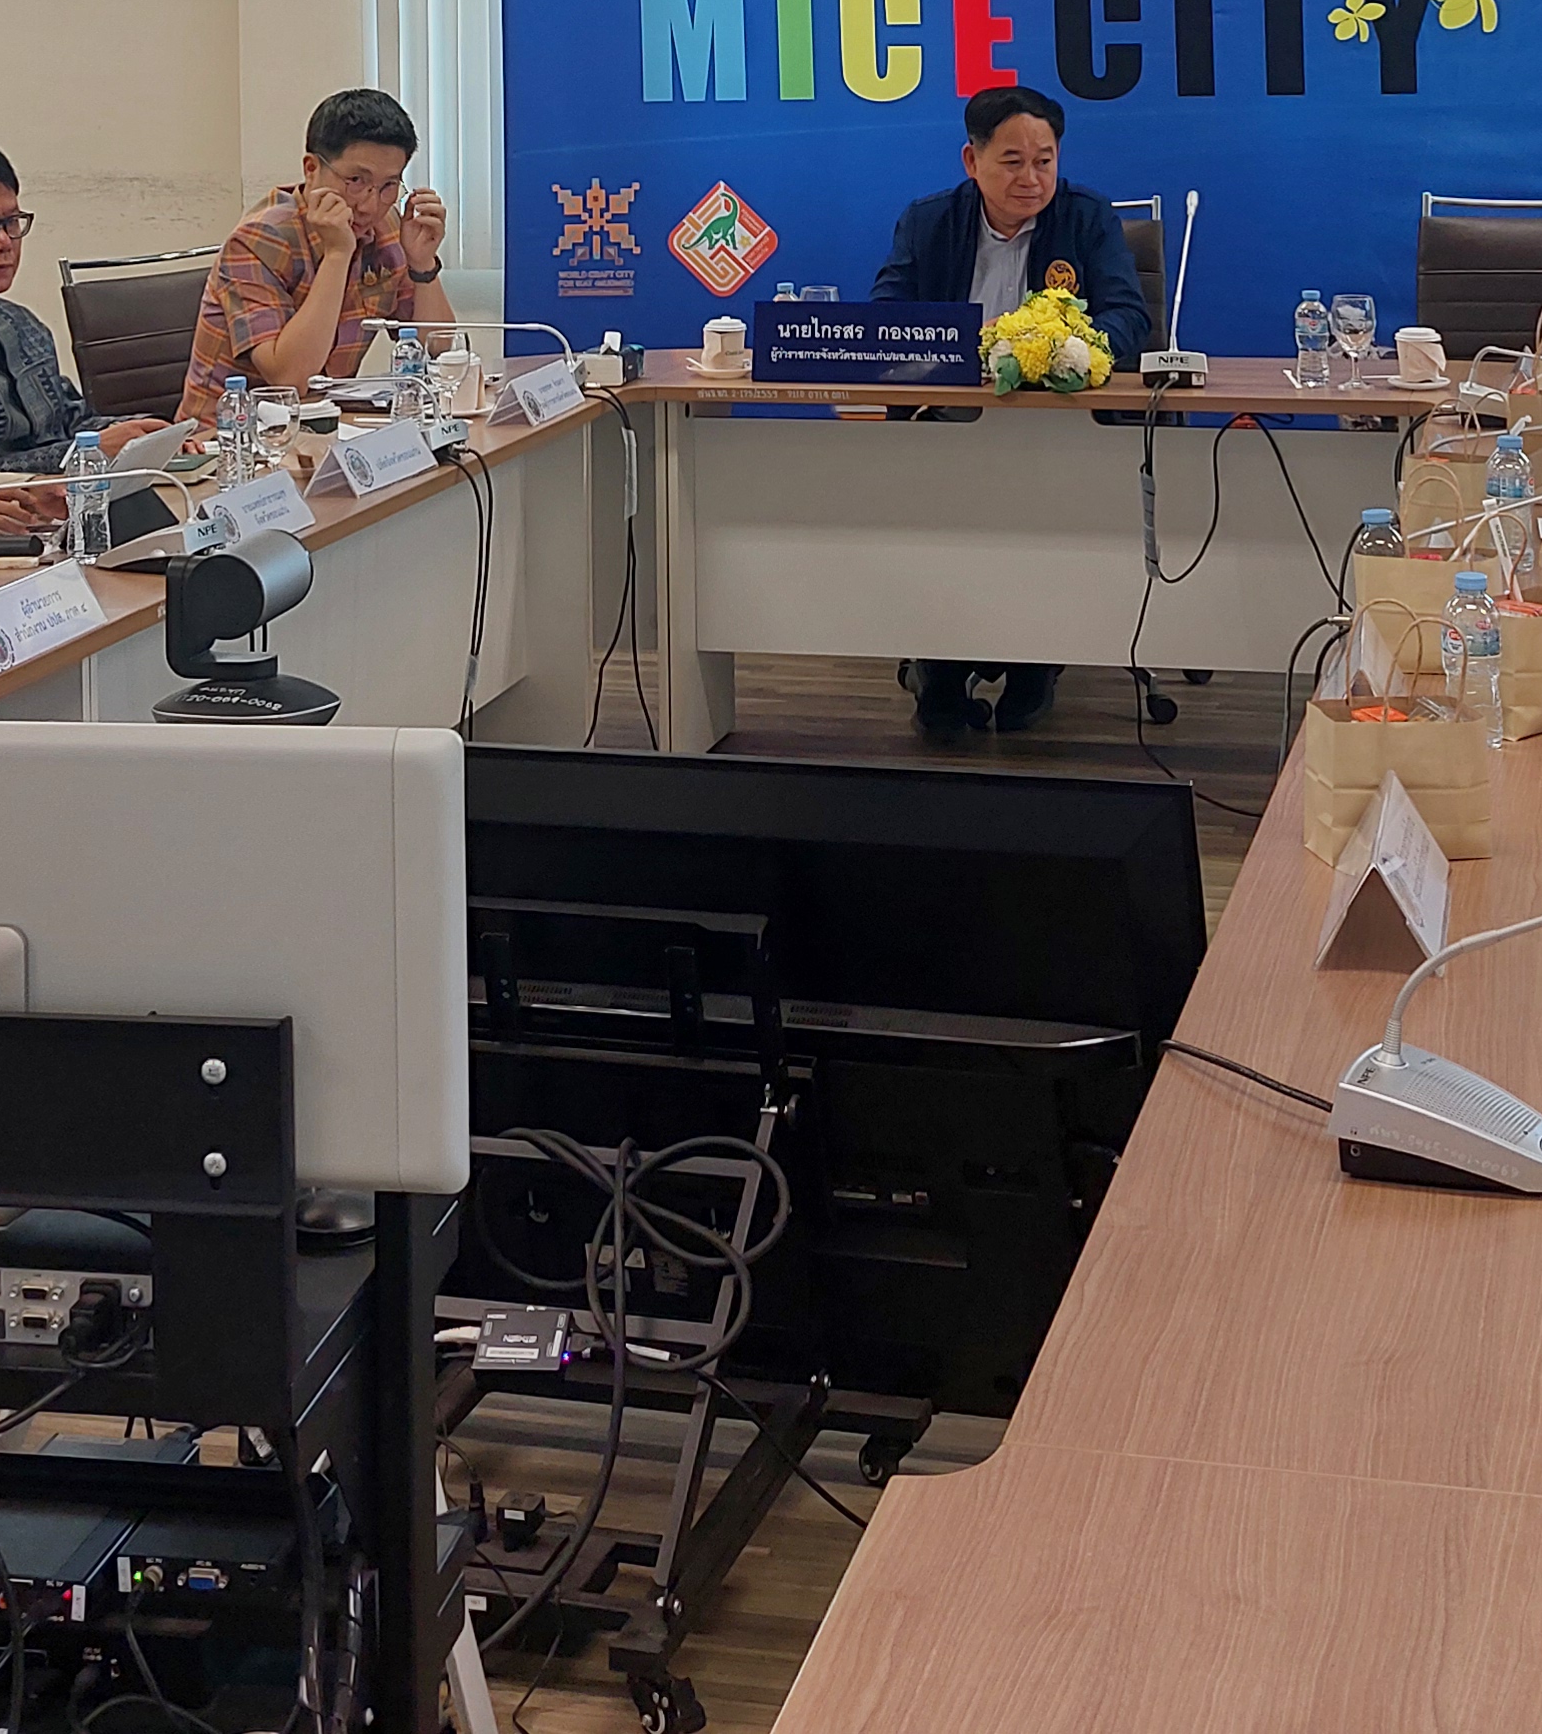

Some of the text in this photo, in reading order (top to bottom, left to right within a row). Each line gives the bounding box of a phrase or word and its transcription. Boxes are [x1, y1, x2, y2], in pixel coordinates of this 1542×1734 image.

[777, 316, 865, 340] นายไกรสร
[1158, 356, 1189, 364] NPE
[441, 423, 460, 436] NPE
[197, 523, 218, 538] NPE
[1357, 1067, 1377, 1086] NPE
